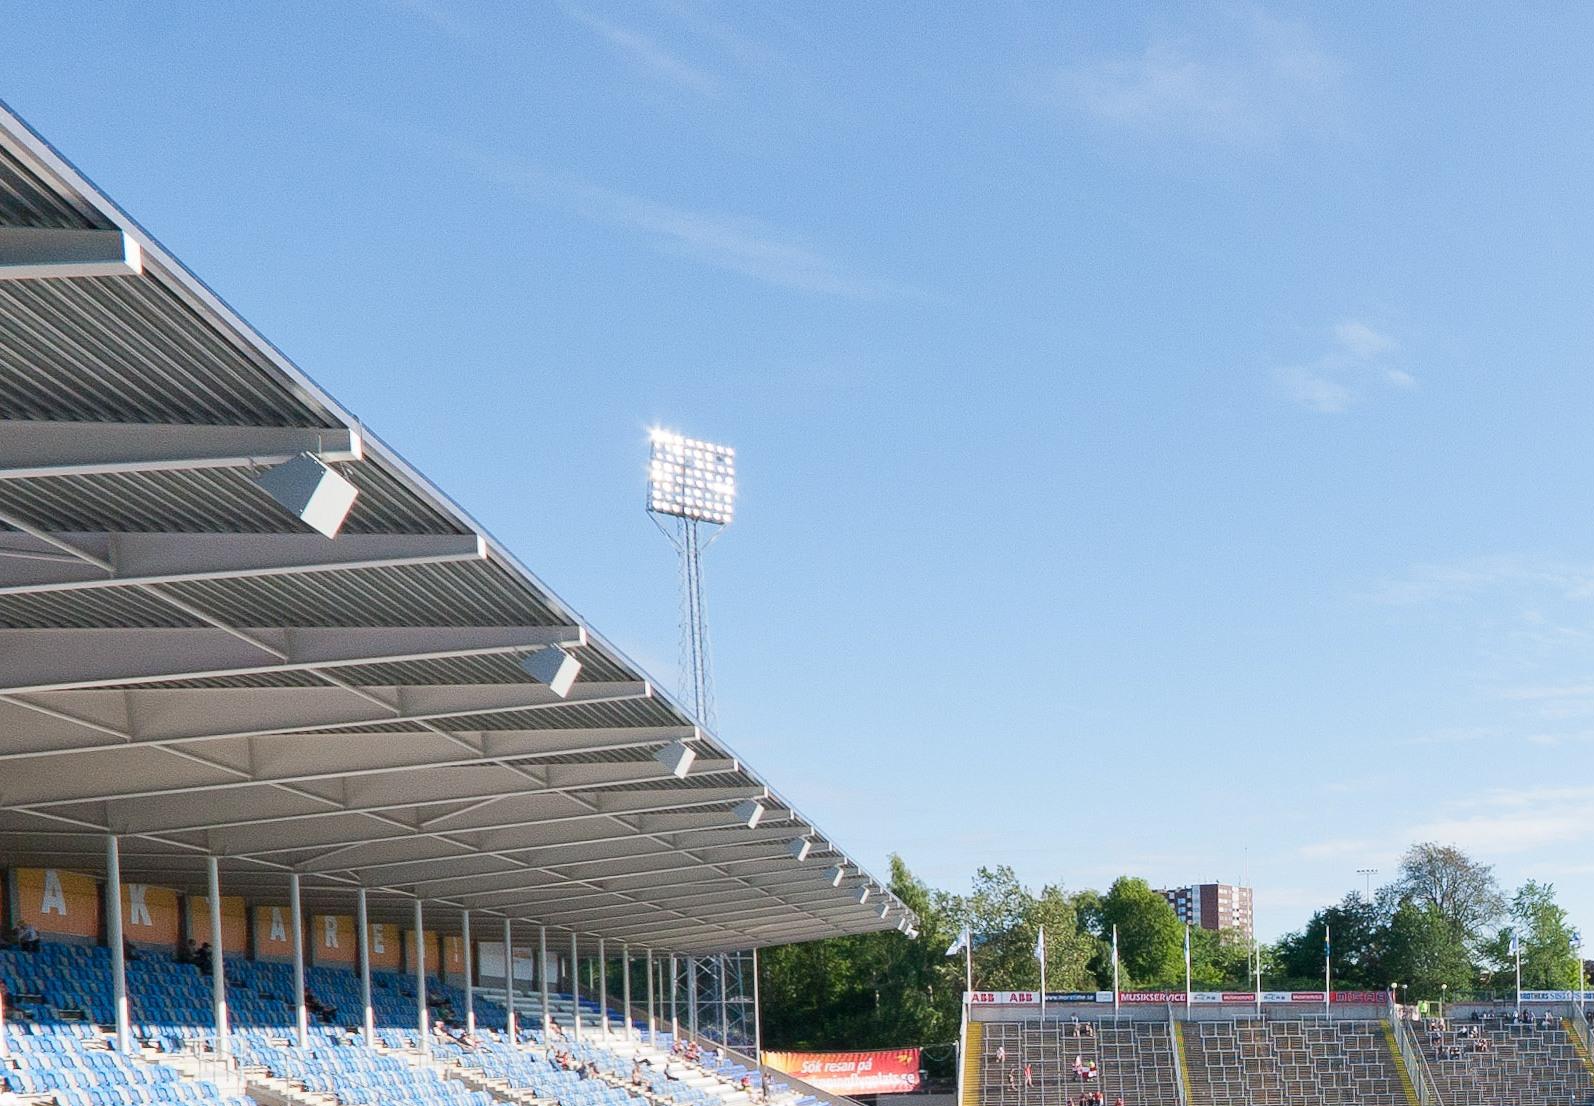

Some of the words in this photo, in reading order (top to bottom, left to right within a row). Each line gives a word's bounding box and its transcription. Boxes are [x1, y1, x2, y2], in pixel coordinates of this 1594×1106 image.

[972, 993, 995, 1002] ABB
[1009, 993, 1033, 1002] ABB
[1121, 993, 1186, 1002] MUSIKSERVICE
[801, 1060, 821, 1073] Sök
[825, 1062, 855, 1073] resan
[857, 1058, 873, 1073] på
